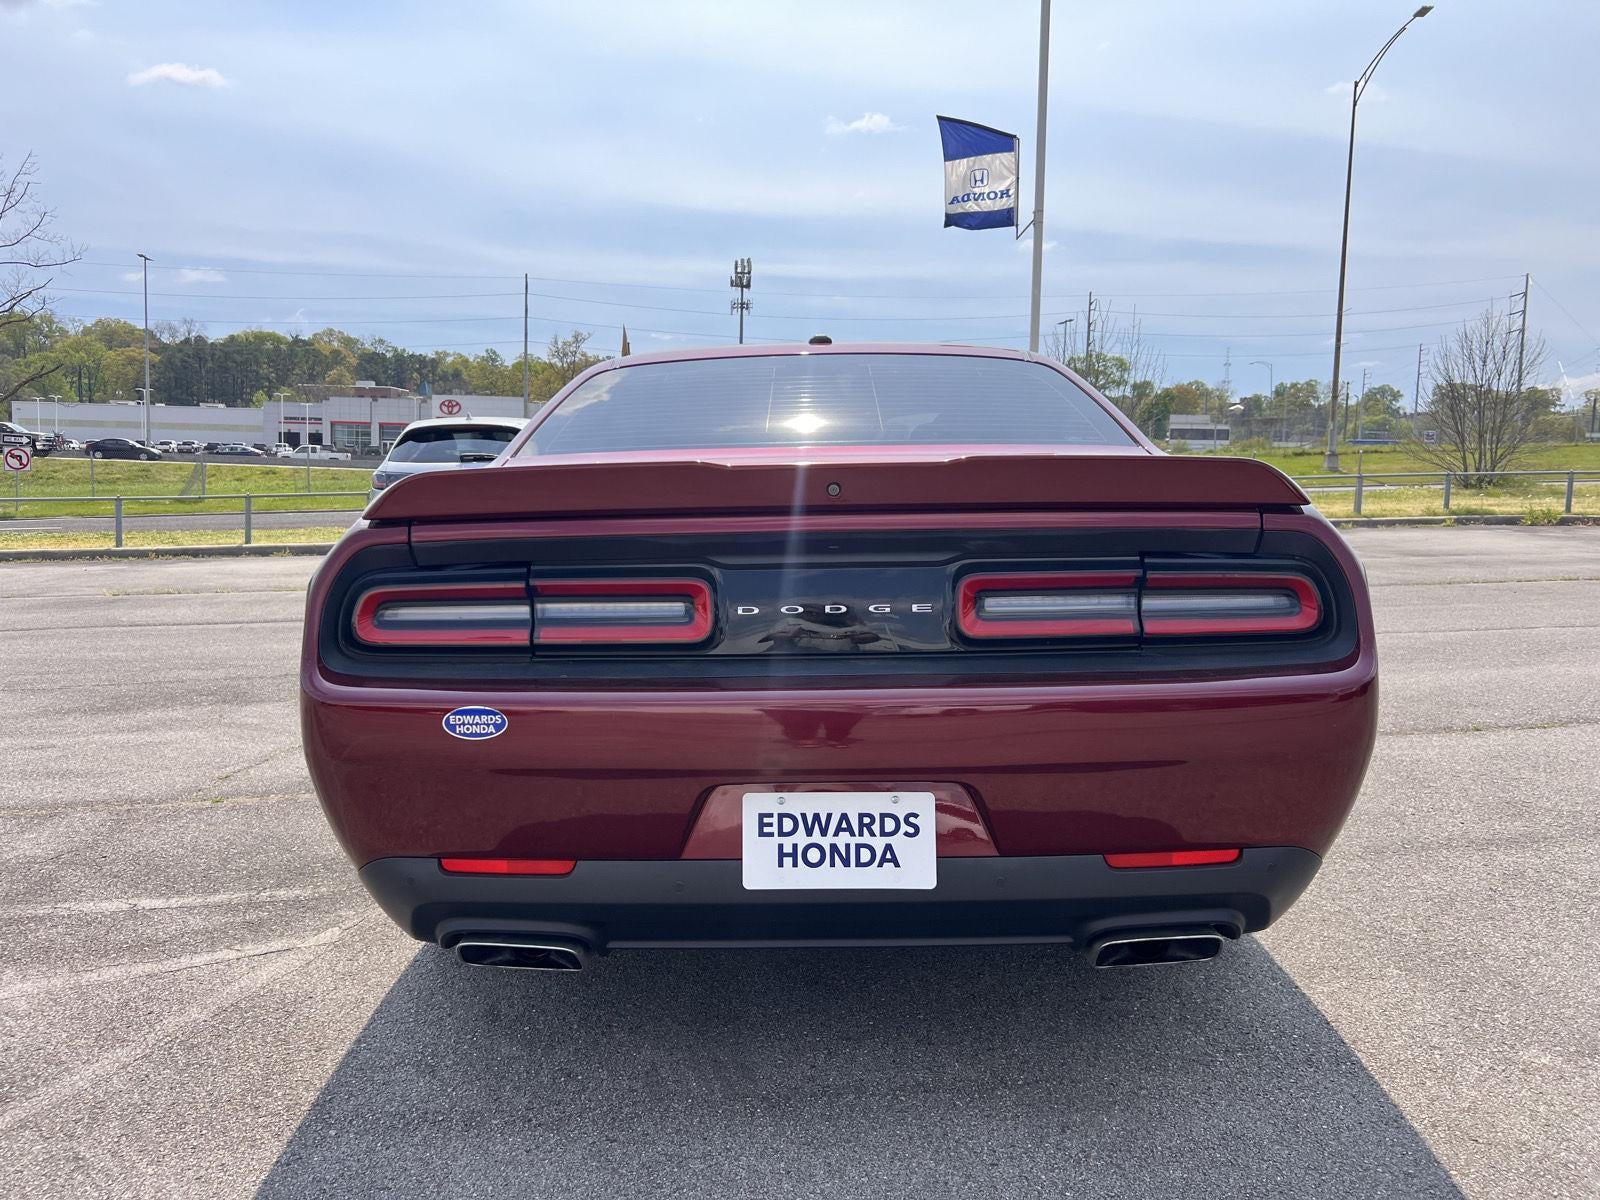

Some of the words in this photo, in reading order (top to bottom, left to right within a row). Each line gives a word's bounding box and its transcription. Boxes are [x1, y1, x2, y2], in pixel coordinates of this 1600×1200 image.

[737, 603, 933, 615] DODGE
[449, 715, 502, 724] EDWARDS
[456, 725, 496, 733] HONDA
[757, 812, 921, 838] EDWARDS
[777, 842, 901, 868] HONDA
